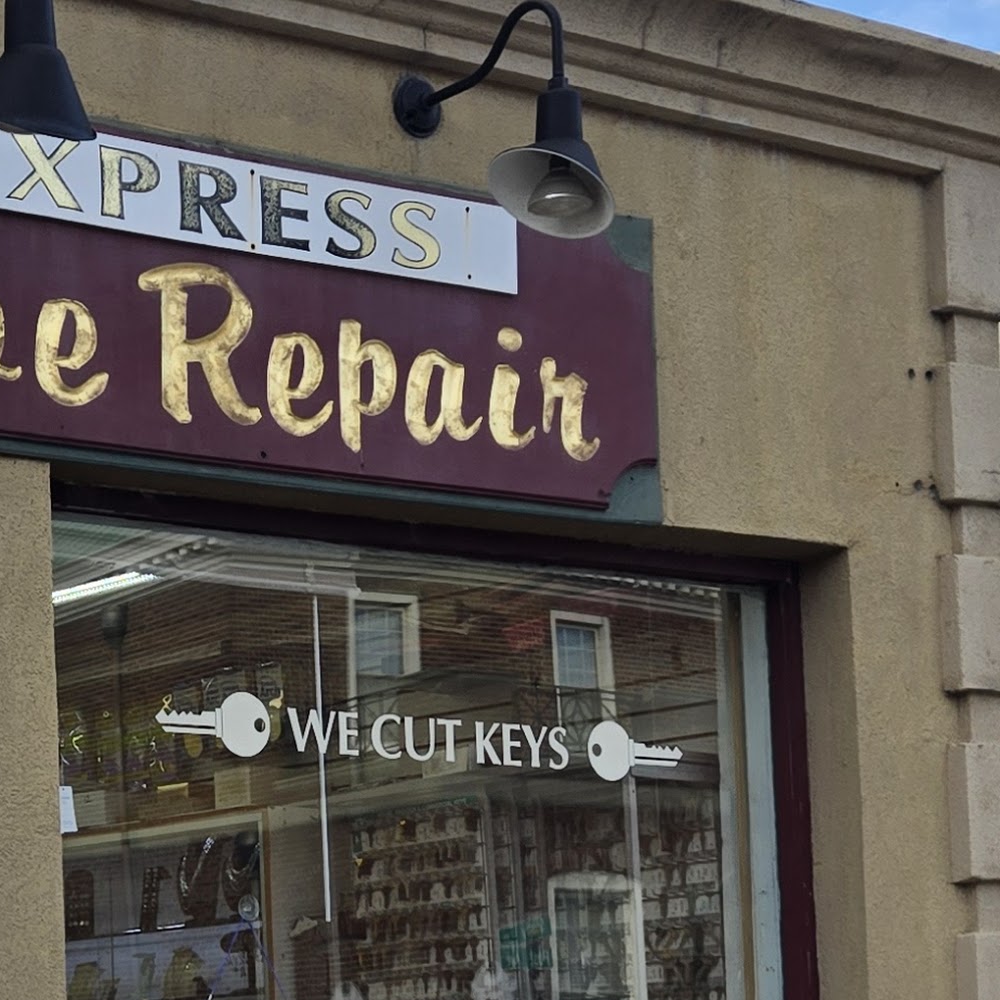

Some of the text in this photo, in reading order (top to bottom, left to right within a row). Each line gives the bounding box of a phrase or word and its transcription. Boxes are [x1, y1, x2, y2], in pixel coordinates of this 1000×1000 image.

[138, 263, 601, 463] Repair
[286, 706, 570, 771] WE CUT KEYS
